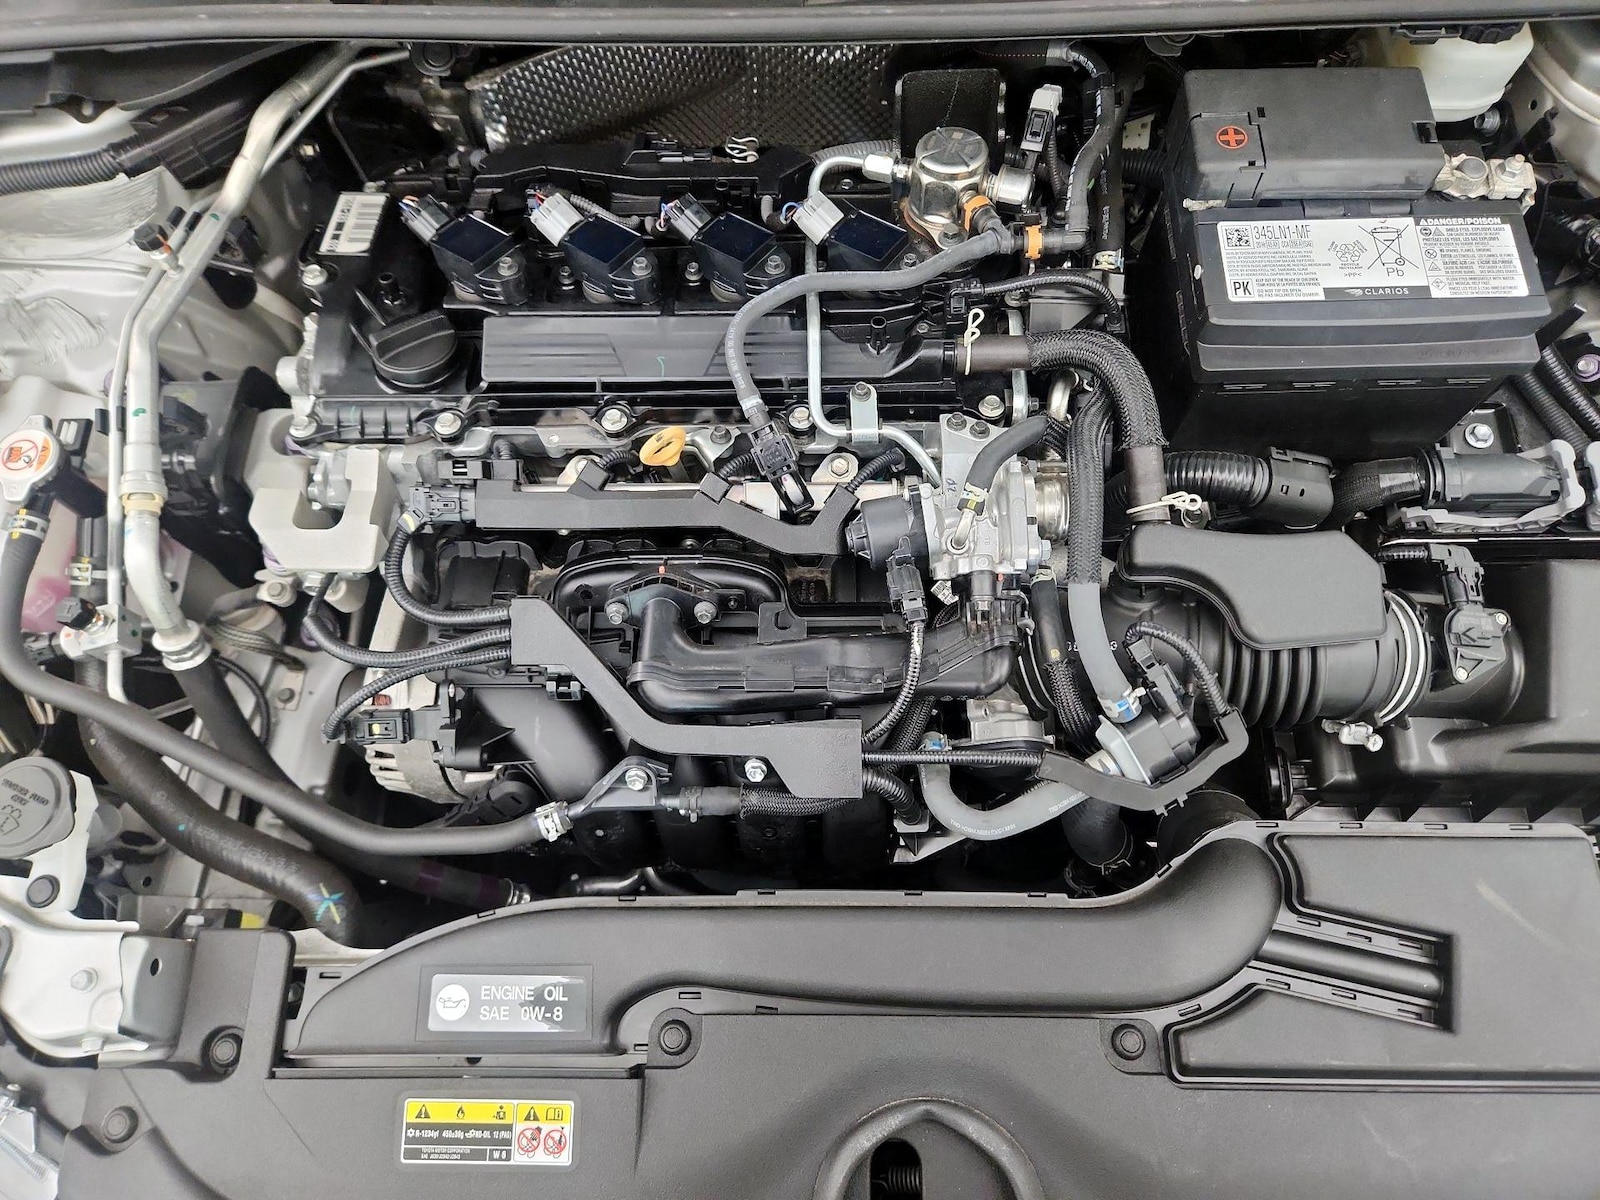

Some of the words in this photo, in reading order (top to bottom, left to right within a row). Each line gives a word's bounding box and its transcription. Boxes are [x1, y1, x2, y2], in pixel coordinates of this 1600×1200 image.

[1427, 217, 1502, 225] DANGER/POISON
[1254, 225, 1312, 240] 345LN1-MF
[1386, 267, 1405, 277] Pb
[1233, 281, 1252, 296] PK
[1364, 287, 1409, 295] CLARIOS
[481, 985, 534, 1000] ENGINE
[543, 986, 568, 1001] OIL
[479, 1006, 510, 1020] SAE
[521, 1006, 563, 1021] 0W-8
[493, 1150, 500, 1159] W
